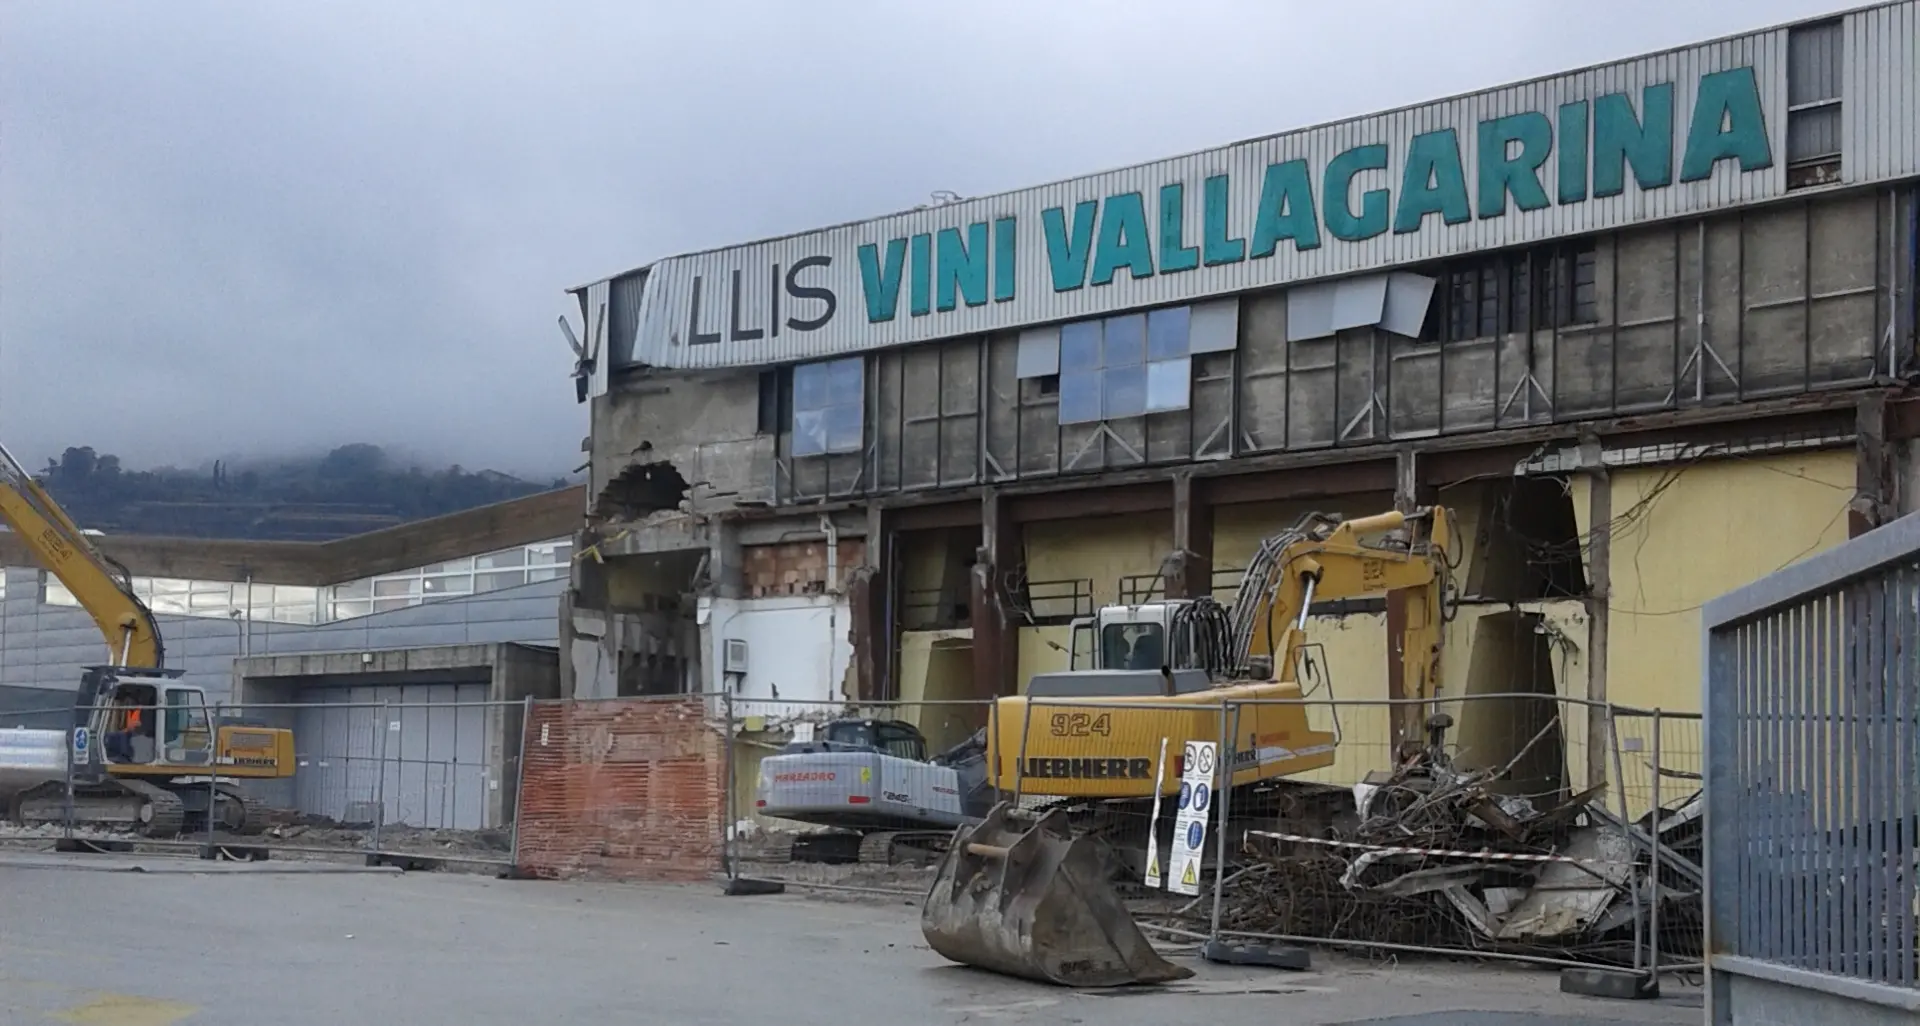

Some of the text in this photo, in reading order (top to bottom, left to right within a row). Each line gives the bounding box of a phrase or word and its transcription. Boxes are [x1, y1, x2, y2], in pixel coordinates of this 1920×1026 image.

[857, 217, 1017, 323] VINI
[1042, 66, 1771, 294] VALLAGARINA
[1051, 713, 1112, 736] 924
[1016, 756, 1152, 779] LIEBHERR
